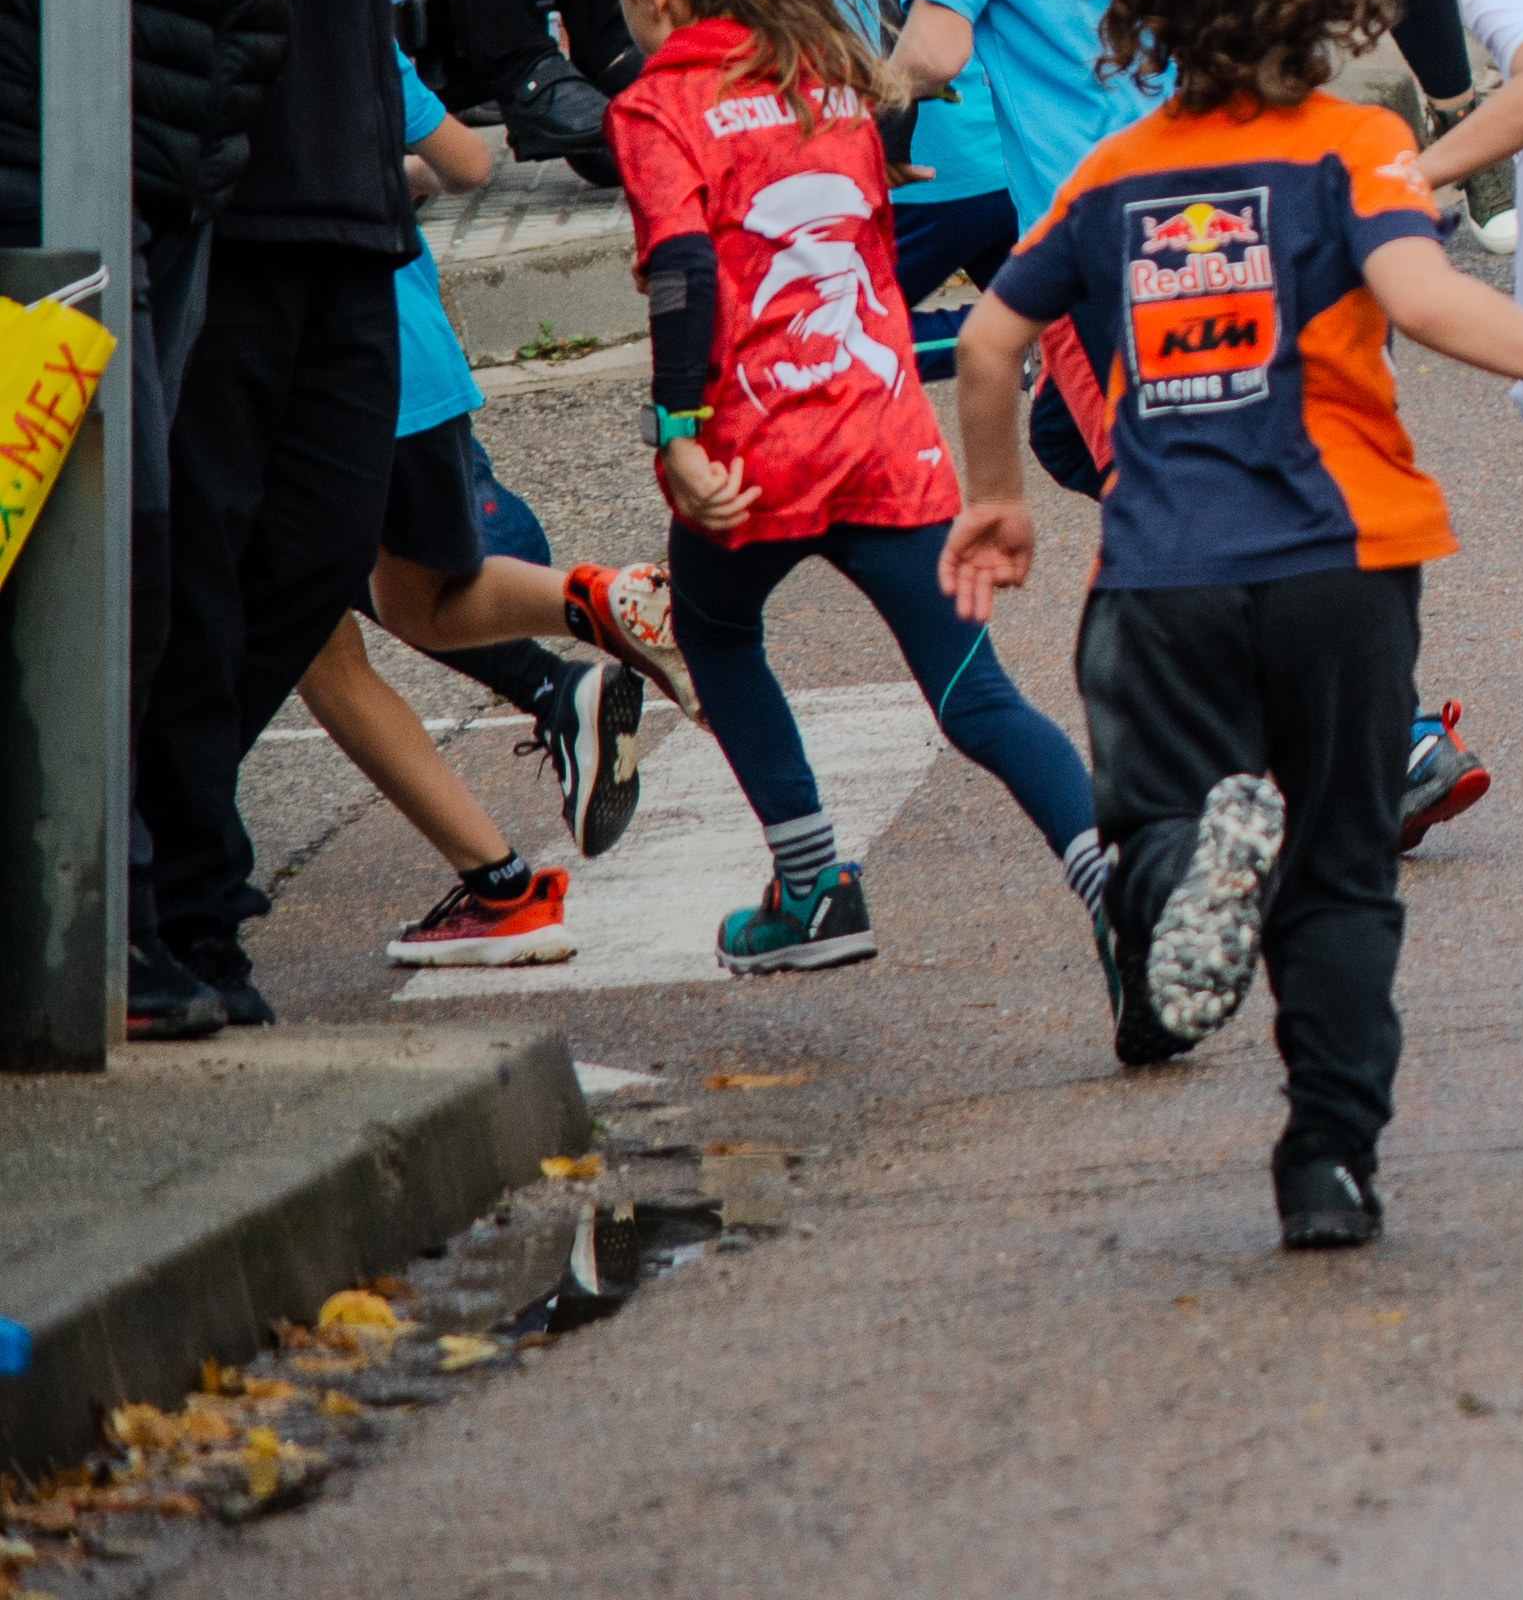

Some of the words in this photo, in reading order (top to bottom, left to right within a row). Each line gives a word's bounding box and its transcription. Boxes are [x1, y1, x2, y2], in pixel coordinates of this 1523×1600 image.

[1130, 253, 1201, 301] Red
[1202, 245, 1273, 294] Bull
[1160, 315, 1258, 358] KTM
